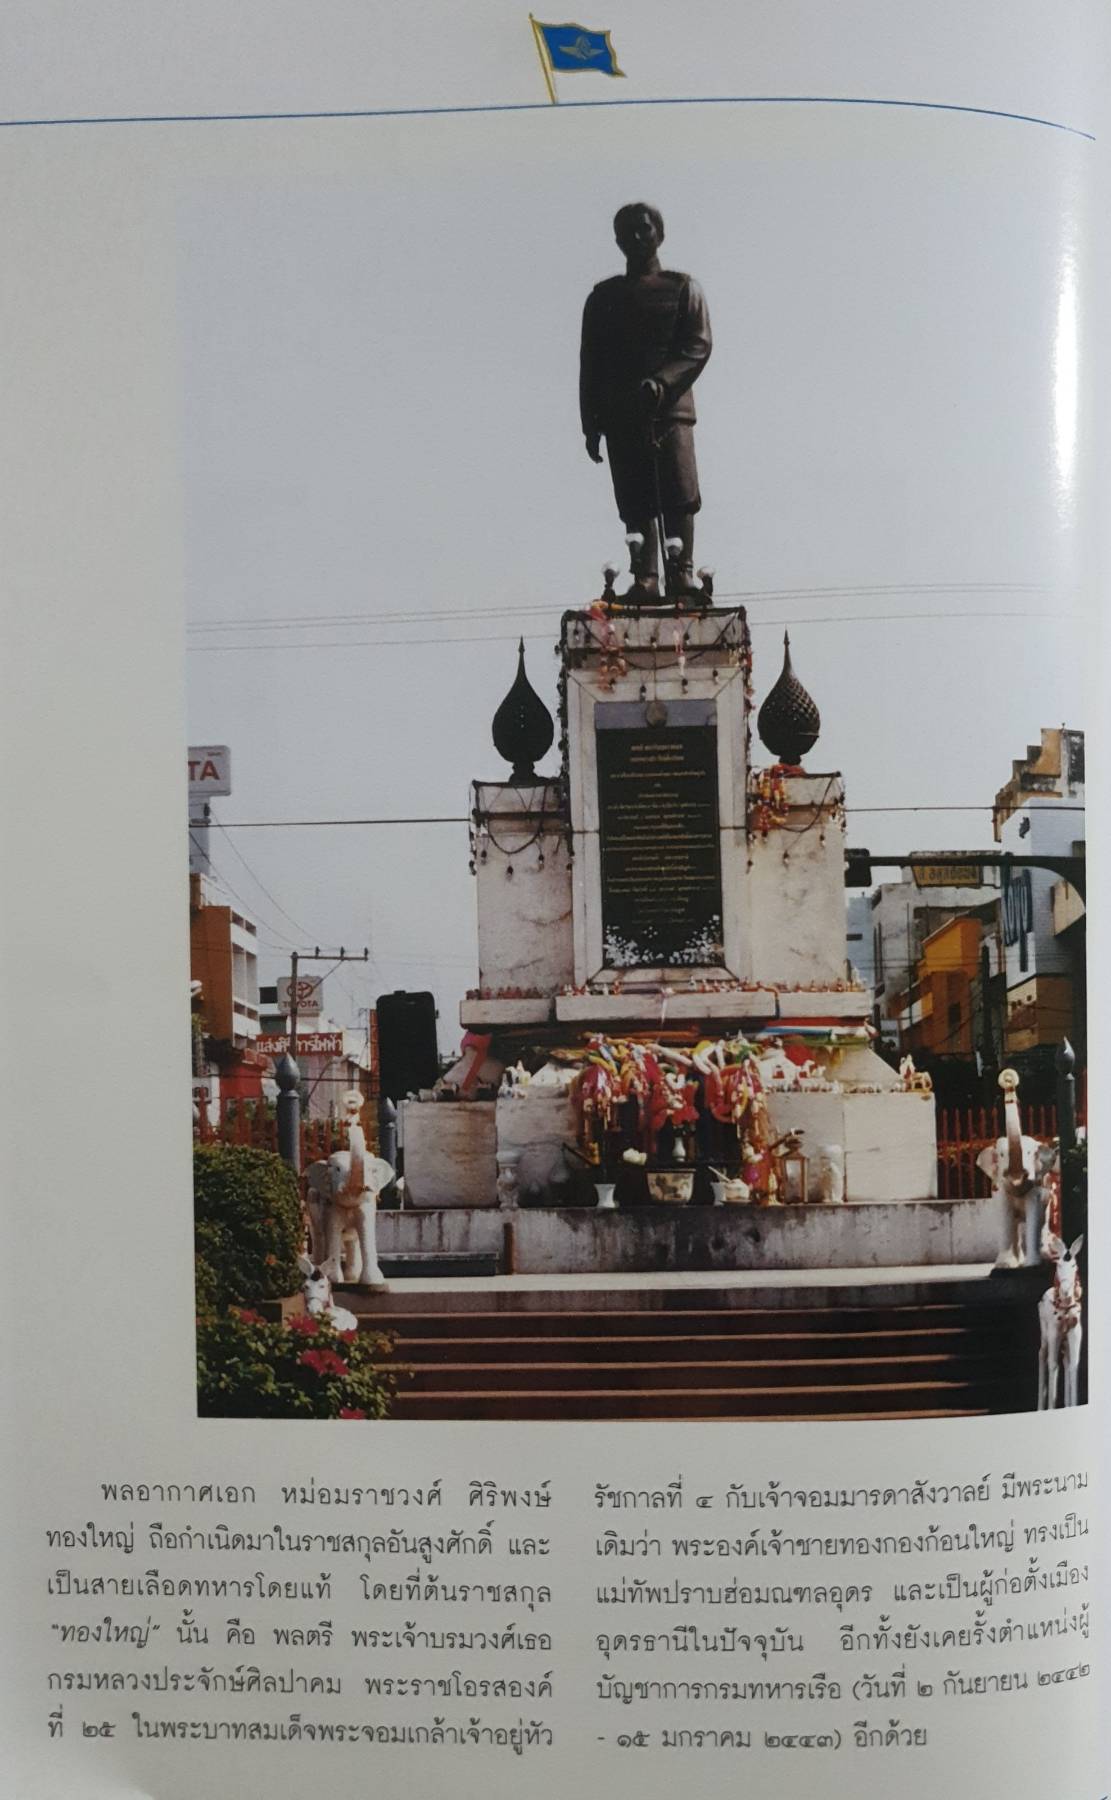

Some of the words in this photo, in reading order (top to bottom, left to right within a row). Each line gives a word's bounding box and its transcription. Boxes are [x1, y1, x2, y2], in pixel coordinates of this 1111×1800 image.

[100, 1483, 256, 1504] พลอากาศเอก
[280, 1476, 443, 1507] หม่อมราชวงศ์
[468, 1479, 553, 1508] ศิริพงษ์
[594, 1473, 683, 1509] รัชกาลที่
[695, 1495, 715, 1509] ๔
[725, 1472, 992, 1509] กับเจ้าจอมมารดาสังวาลย์
[1001, 1471, 1088, 1500] มีพระนาม
[45, 1520, 135, 1555] ทองใหญ่
[148, 1519, 495, 1565] ถือกำเนิดมาในราชสกุลอันสูงศักดิ์
[508, 1537, 551, 1556] และ
[596, 1528, 662, 1557] เดิมว่า
[671, 1518, 1015, 1557] พระองค์เจ้าชายทองกองก้อนใหญ่
[1023, 1512, 1089, 1545] ทรงเป็น
[47, 1568, 332, 1600] เป็นสายเลือดทหารโดยแท้
[359, 1567, 552, 1613] โดยที่ต้นราชสกุล
[596, 1575, 873, 1612] แม่ทัพปราบฮ่อมณฑลอุดร
[893, 1556, 1090, 1606] และเป็นผู้ก่อตั้งเมือง
[175, 1608, 209, 1645] นั้น
[226, 1617, 256, 1645] คือ
[272, 1619, 334, 1647] พลตรี
[350, 1620, 552, 1651] พระเจ้าบรมวงศ์เธอ
[595, 1624, 805, 1663] อุดรธานีในปัจจุบัน
[840, 1602, 1090, 1651] อีกทั้งยังเคยรั้งตำแหน่งผู้
[47, 1664, 342, 1695] กรมหลวงประจักษ์ศิลปาคม
[364, 1669, 554, 1698] พระราชโอรสองค์
[596, 1671, 842, 1705] บัญชาการกรมทหารเรือ
[851, 1662, 906, 1702] (วันที่
[916, 1679, 934, 1698] ๒
[942, 1670, 1029, 1696] กันยายน
[1036, 1662, 1091, 1687] ๒๔๔๒
[47, 1703, 64, 1739] ที่
[82, 1720, 117, 1738] ๒๕
[132, 1711, 553, 1756] ในพระบาทสมเด็จพระจอมเกล้าเจ้าอยู่หัว
[616, 1730, 651, 1749] ๑๕
[661, 1729, 752, 1749] มกราคม
[763, 1728, 842, 1751] ๒๔๔๓)
[852, 1718, 928, 1748] อีกด้วย
